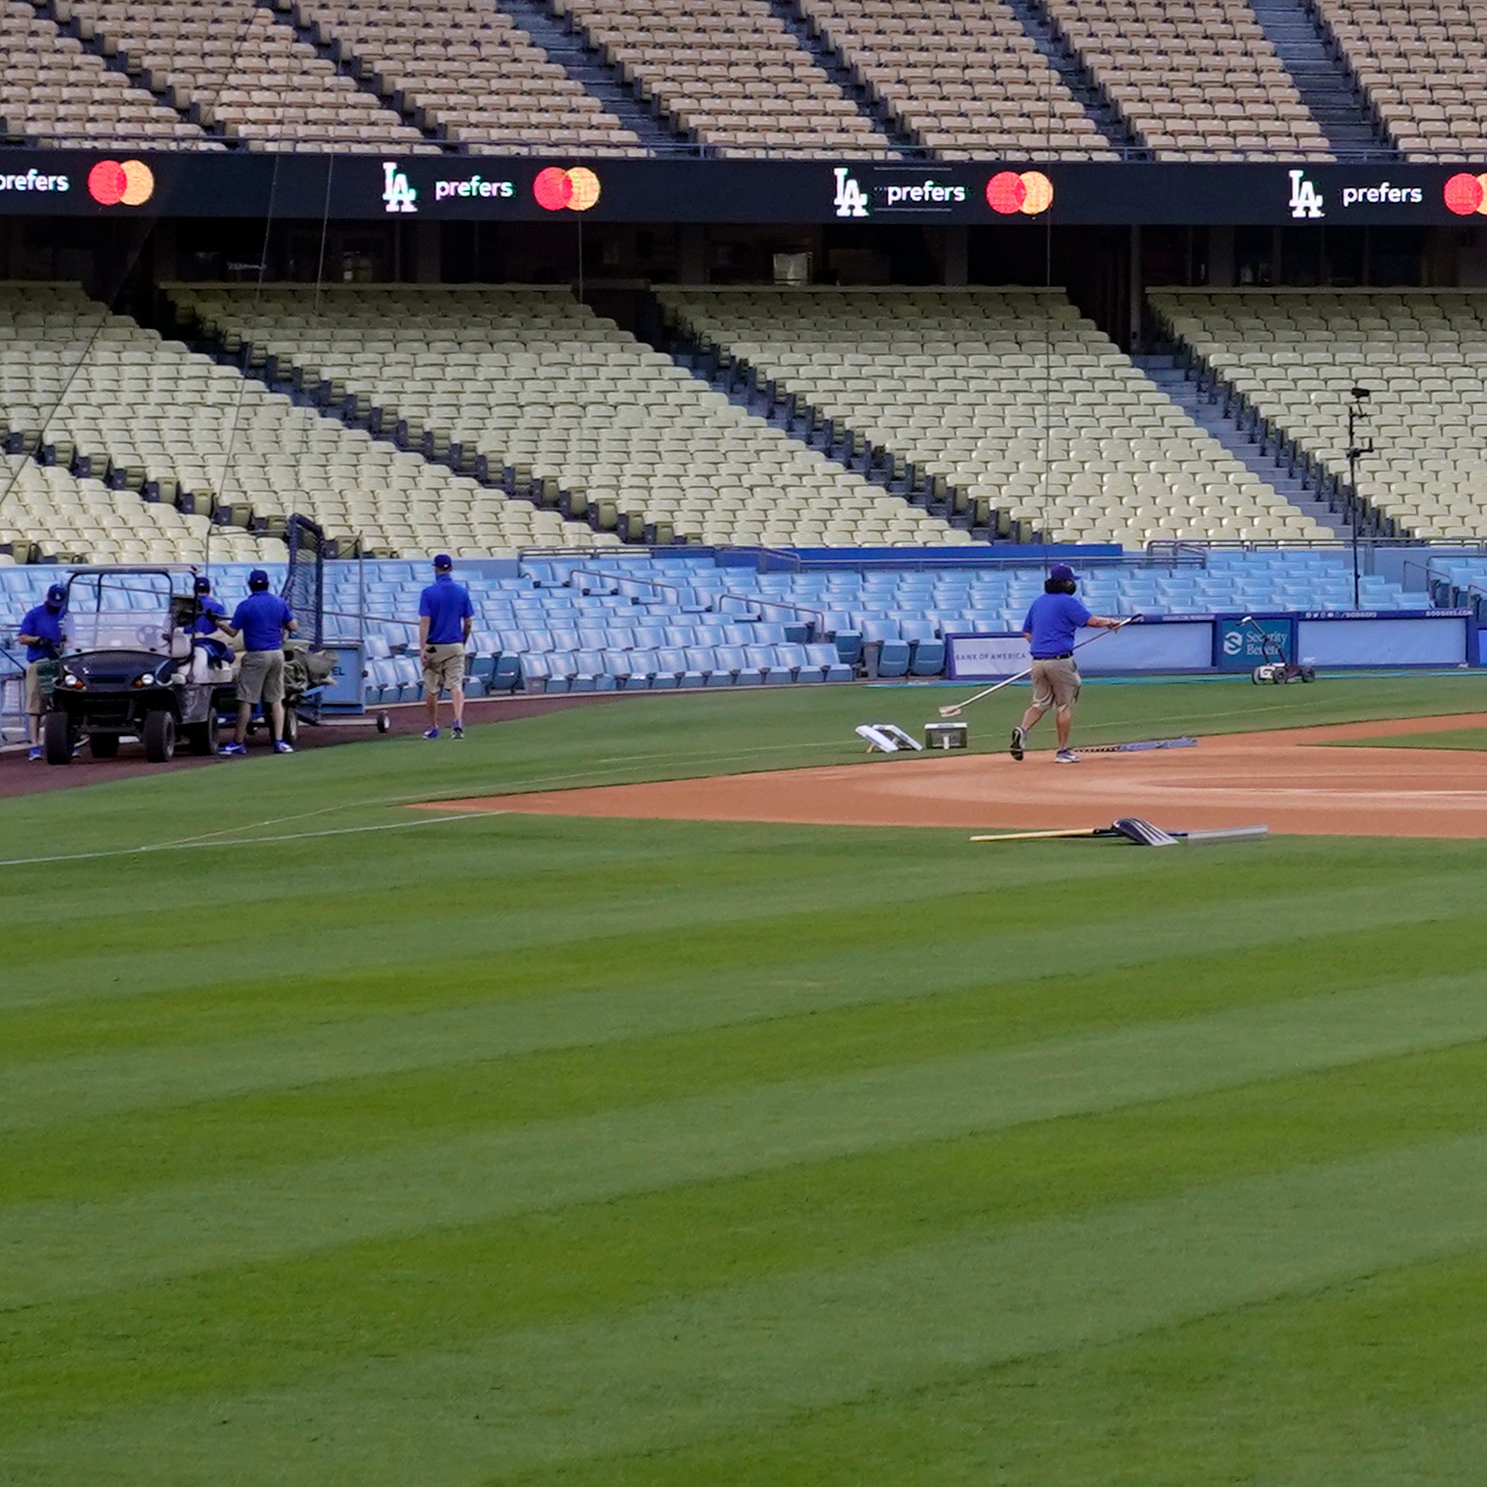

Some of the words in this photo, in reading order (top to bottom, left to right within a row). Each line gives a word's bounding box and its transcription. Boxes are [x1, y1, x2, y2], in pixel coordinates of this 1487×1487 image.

[383, 162, 417, 212] LA
[436, 176, 513, 199] prefers
[834, 167, 867, 217] LA
[887, 181, 965, 205] prefers
[1289, 170, 1325, 218] LA
[1344, 182, 1422, 206] prefers
[956, 653, 978, 661] BANK
[992, 652, 1026, 661] AMERICA
